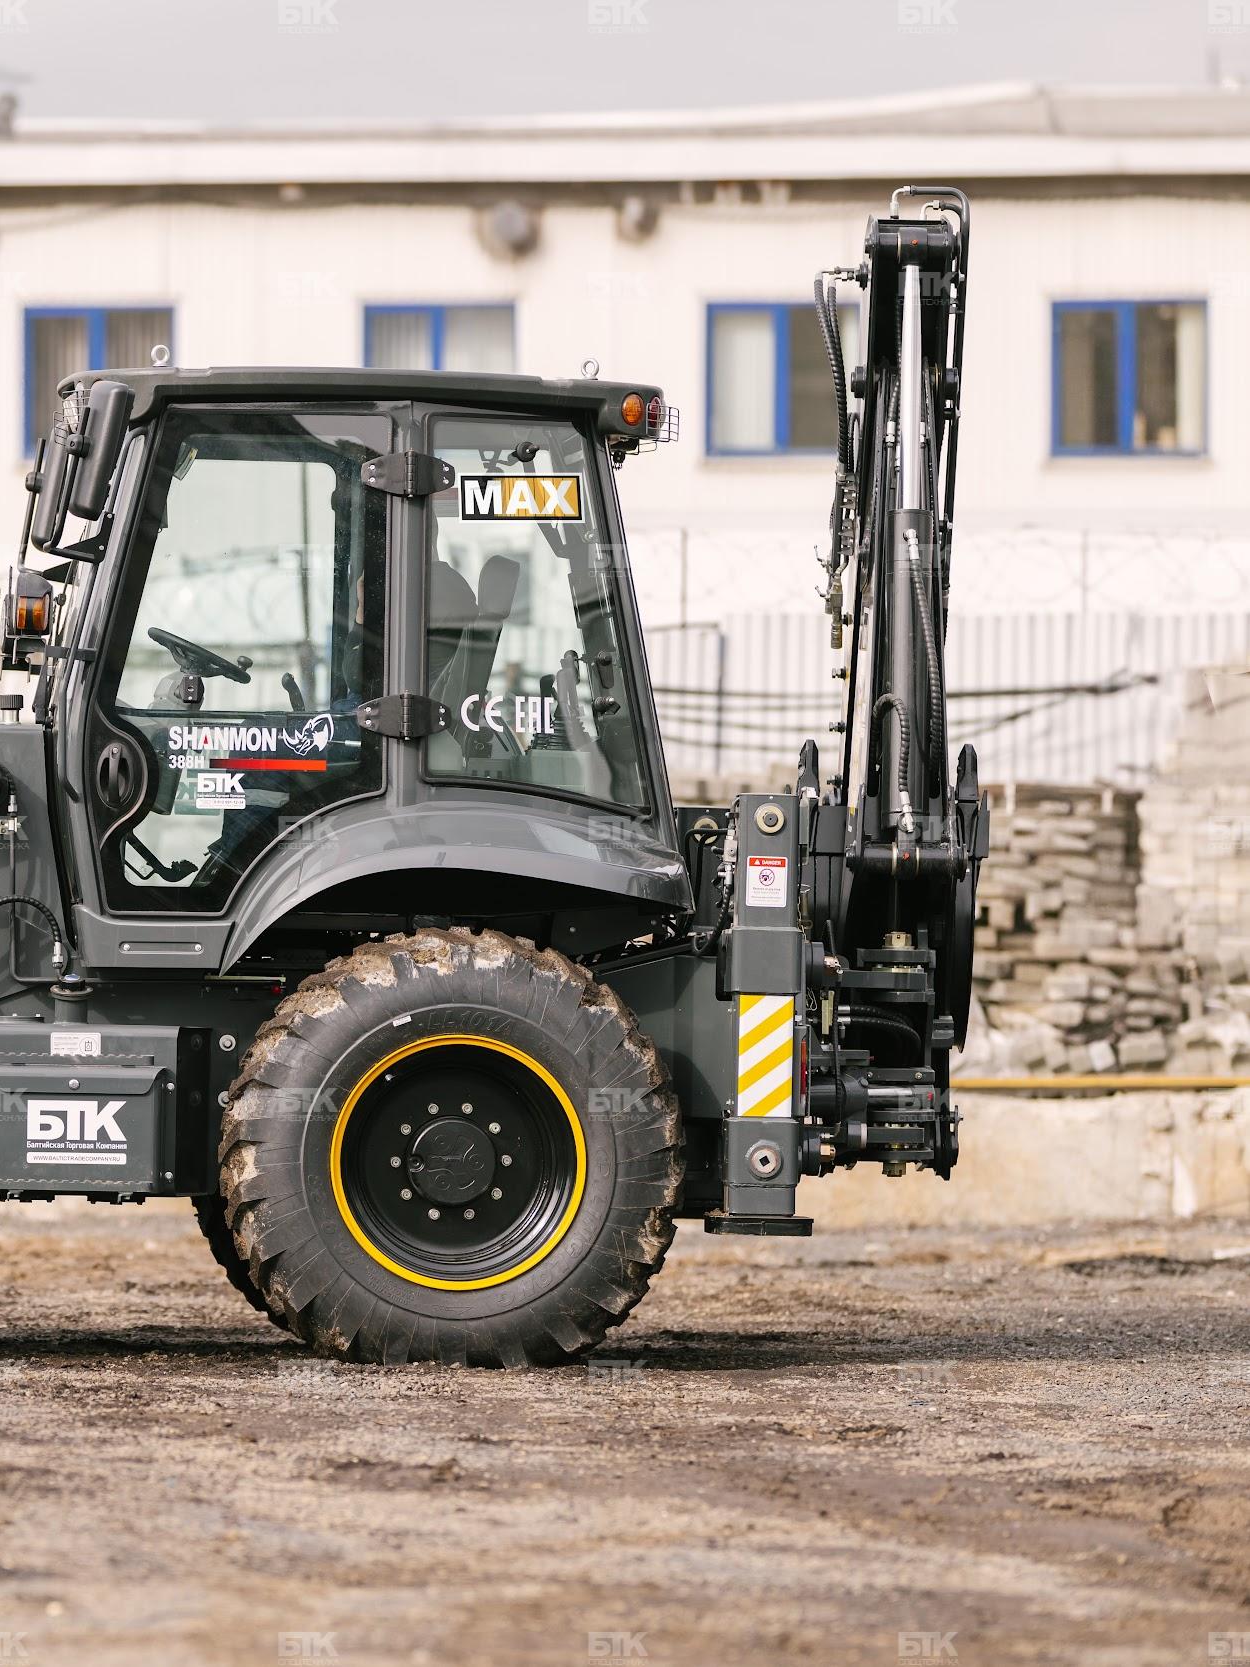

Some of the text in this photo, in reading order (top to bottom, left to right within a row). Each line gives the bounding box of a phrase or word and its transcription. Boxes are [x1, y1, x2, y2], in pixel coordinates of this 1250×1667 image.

[464, 479, 575, 515] MAX
[168, 726, 277, 751] SHANMON
[168, 754, 205, 769] 388H
[197, 773, 245, 793] БТК
[27, 1100, 127, 1141] БТК
[26, 1141, 127, 1150] Балтийская Торговая Компания
